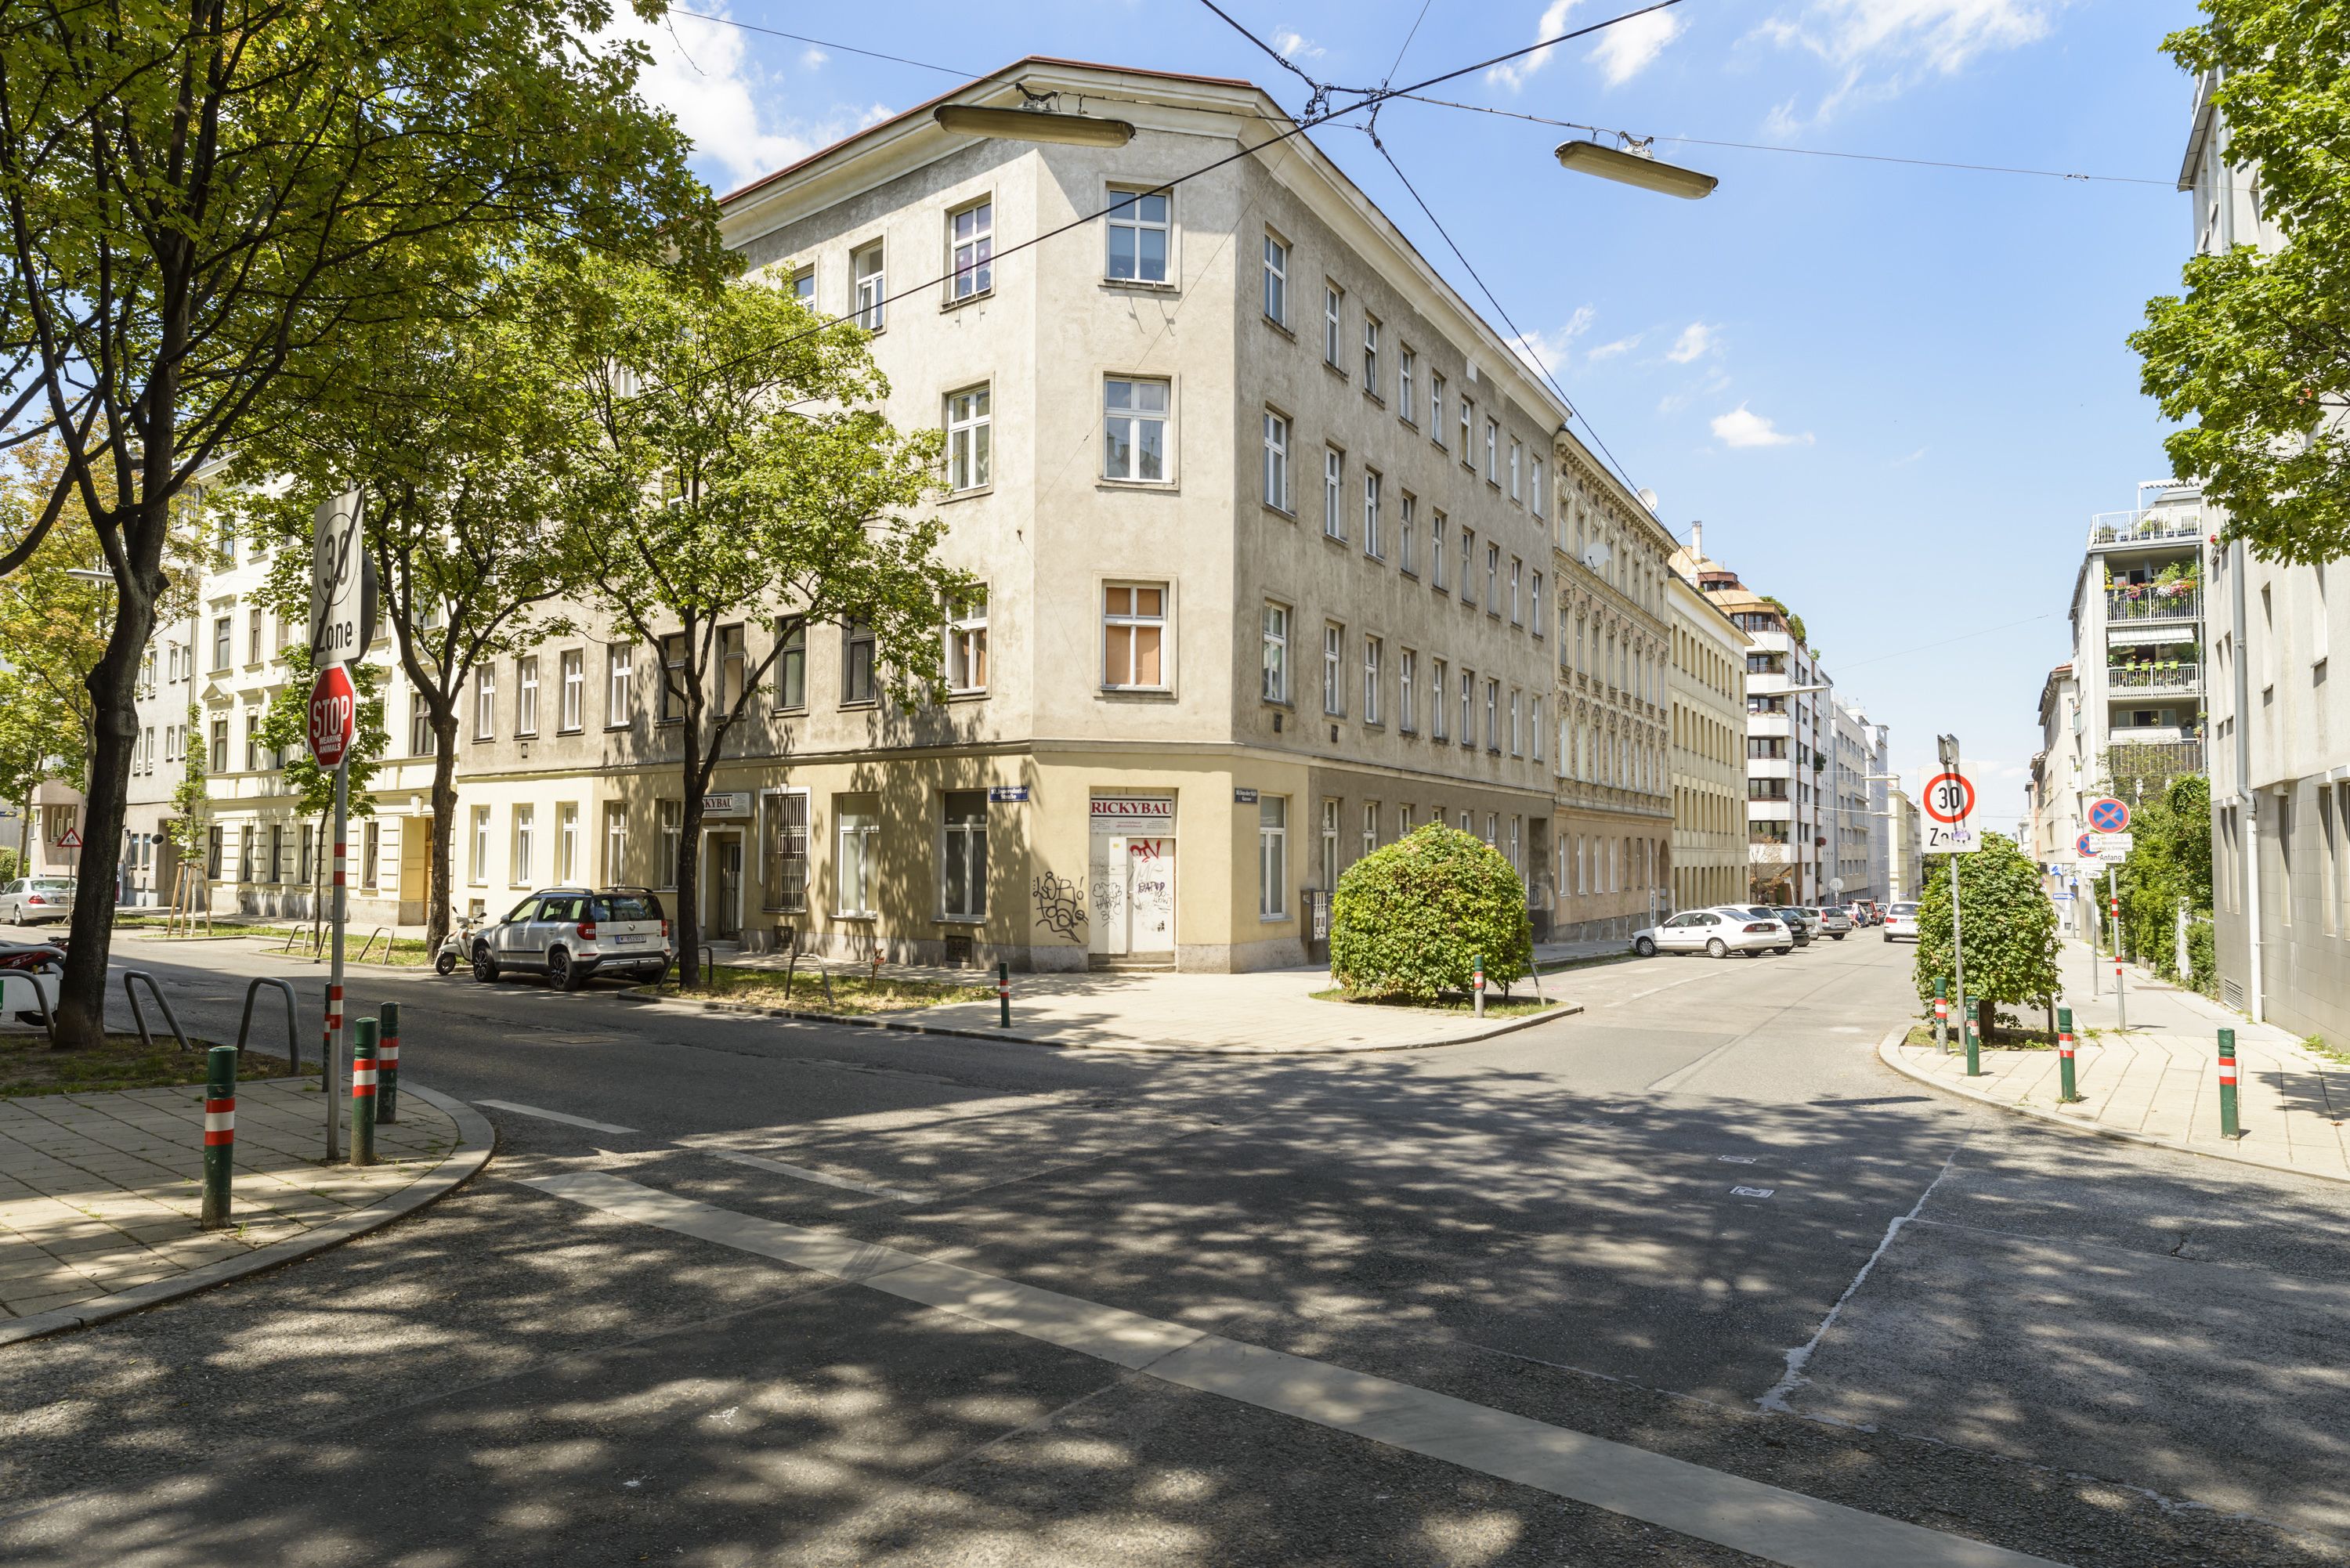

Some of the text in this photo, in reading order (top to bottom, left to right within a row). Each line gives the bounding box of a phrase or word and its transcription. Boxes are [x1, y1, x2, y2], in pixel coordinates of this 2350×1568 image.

[324, 529, 349, 589] 30
[313, 695, 350, 739] STOP
[319, 734, 342, 746] WEARING
[320, 742, 342, 753] ANIMALS
[703, 798, 732, 807] KYBAU
[1939, 786, 1960, 809] 30
[1091, 802, 1172, 814] RICKYBAU
